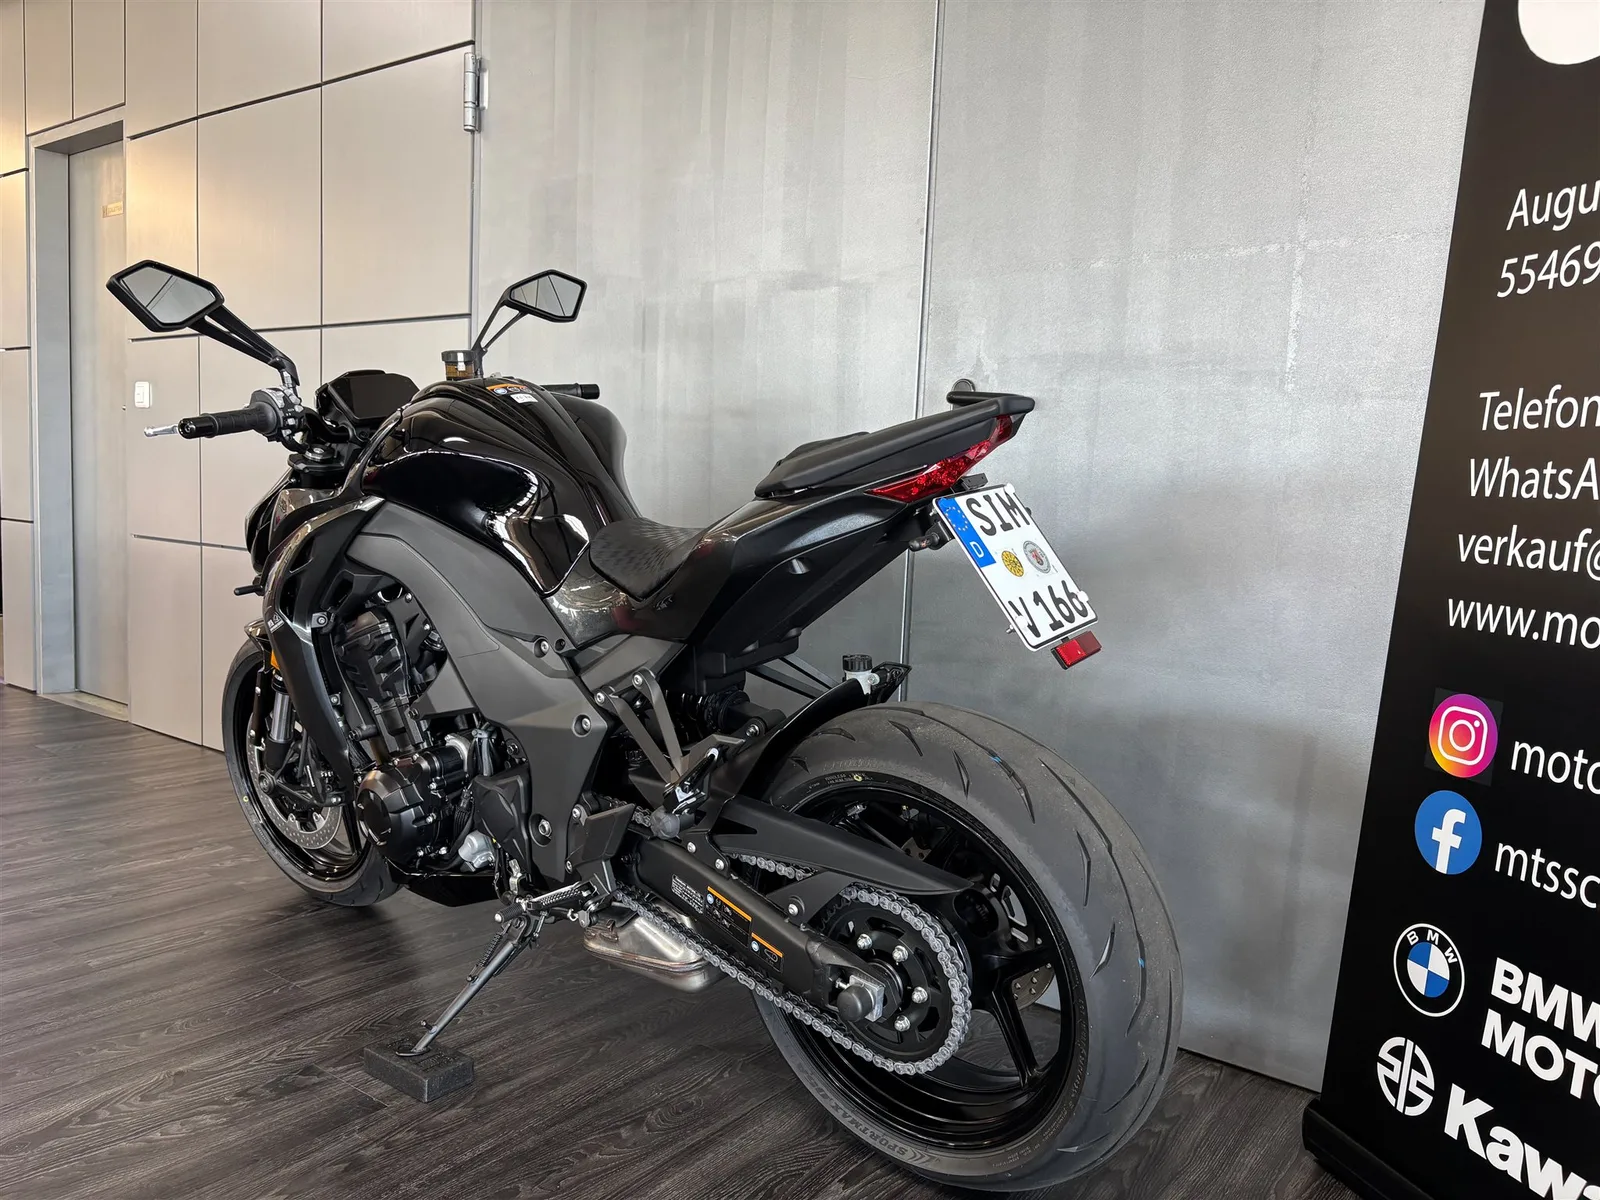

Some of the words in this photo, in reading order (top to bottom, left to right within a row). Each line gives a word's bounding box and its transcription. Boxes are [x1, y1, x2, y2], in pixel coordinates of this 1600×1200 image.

[1505, 180, 1600, 231] Augu
[1496, 241, 1600, 298] 55469
[1479, 384, 1600, 430] Telefon
[1470, 456, 1599, 500] WhatsA
[966, 490, 1030, 536] SIM
[969, 541, 985, 559] D
[1033, 580, 1089, 631] 166
[1448, 598, 1600, 649] www.mo
[1494, 843, 1600, 908] mtssc
[1406, 929, 1458, 964] BMW
[1481, 1008, 1600, 1107] MOT
[829, 1101, 909, 1157] SPORTMAX
